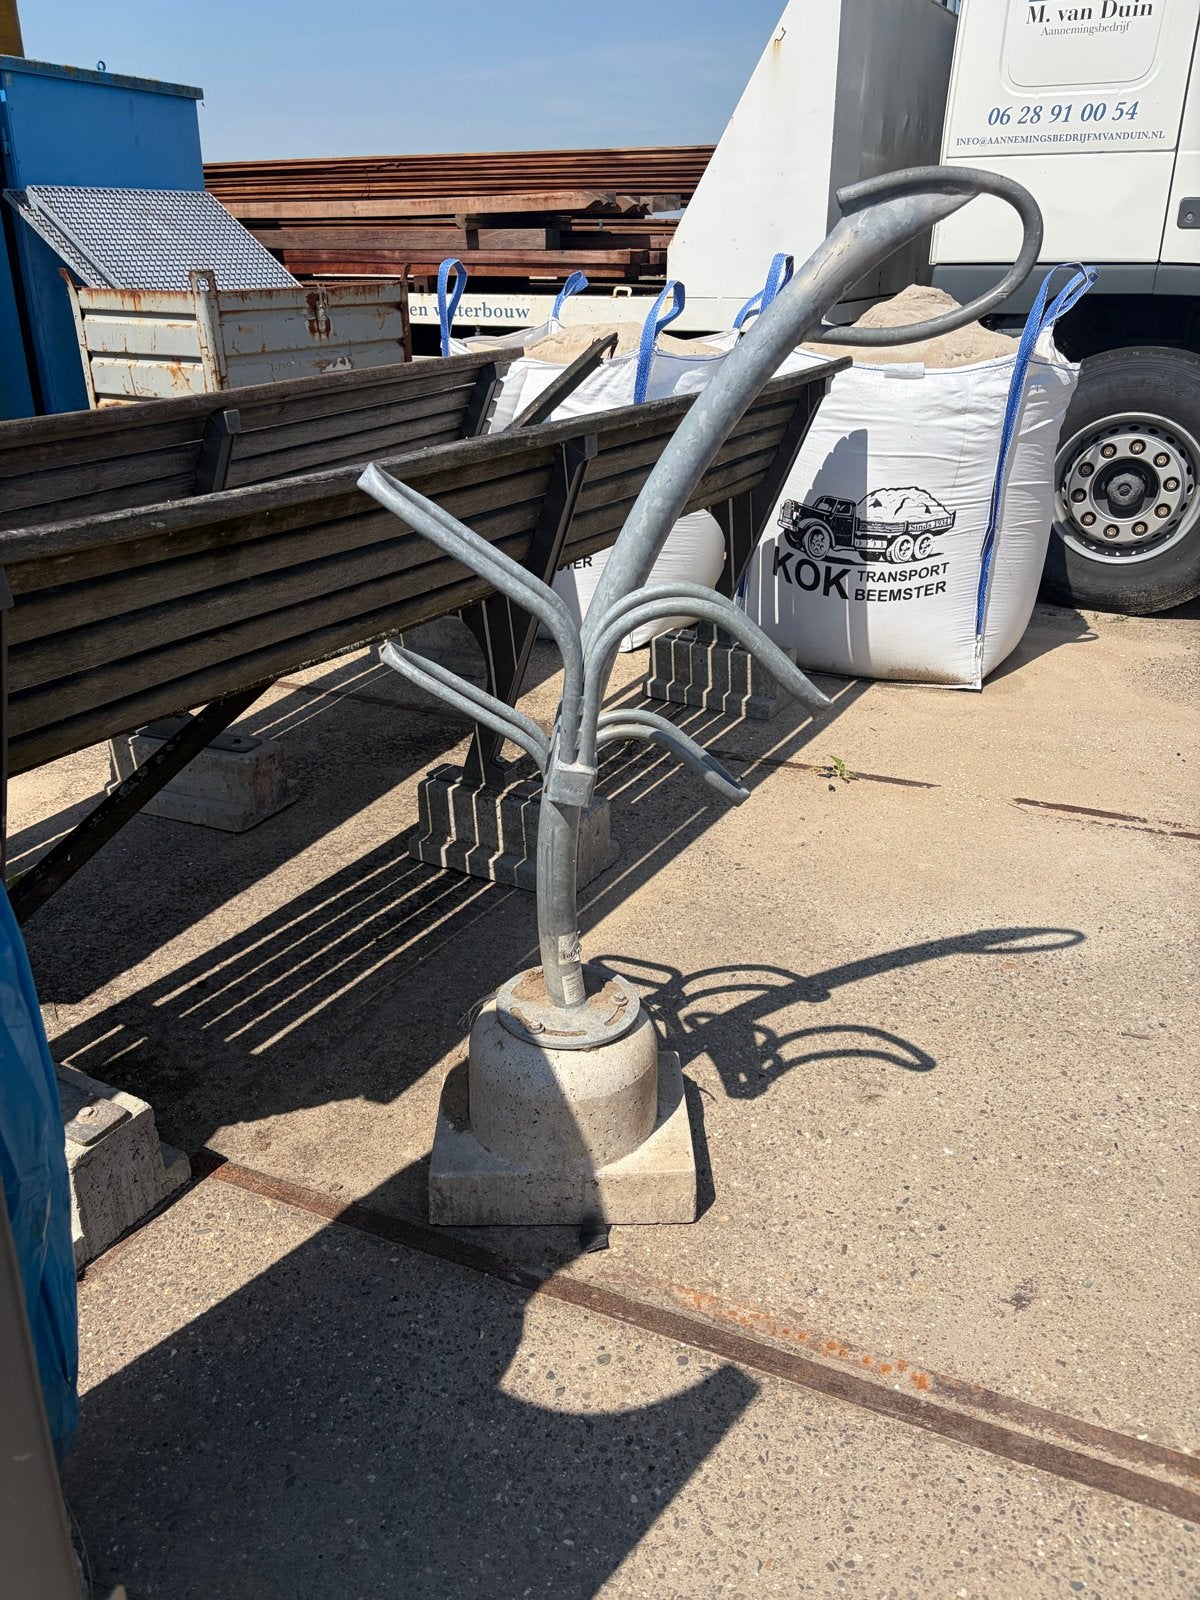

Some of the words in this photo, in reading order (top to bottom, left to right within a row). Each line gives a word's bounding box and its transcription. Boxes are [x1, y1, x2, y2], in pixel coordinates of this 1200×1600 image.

[1026, 5, 1051, 25] M.
[1058, 6, 1093, 22] van
[1099, 0, 1154, 19] Duin
[1040, 21, 1131, 36] Aannemingsbedrijf
[987, 106, 1013, 126] 06
[1017, 105, 1043, 125] 28
[1048, 104, 1073, 124] 91
[1080, 102, 1107, 122] 00
[1112, 101, 1139, 121] 54
[956, 131, 1165, 146] INFO@AANNEMINGSBEDRIJFMVANDUIN.NL
[409, 304, 428, 316] en
[433, 302, 530, 319] terbouw
[772, 546, 850, 600] KOK
[857, 562, 950, 582] TRANSPORT
[854, 581, 947, 602] BEEMSTER
